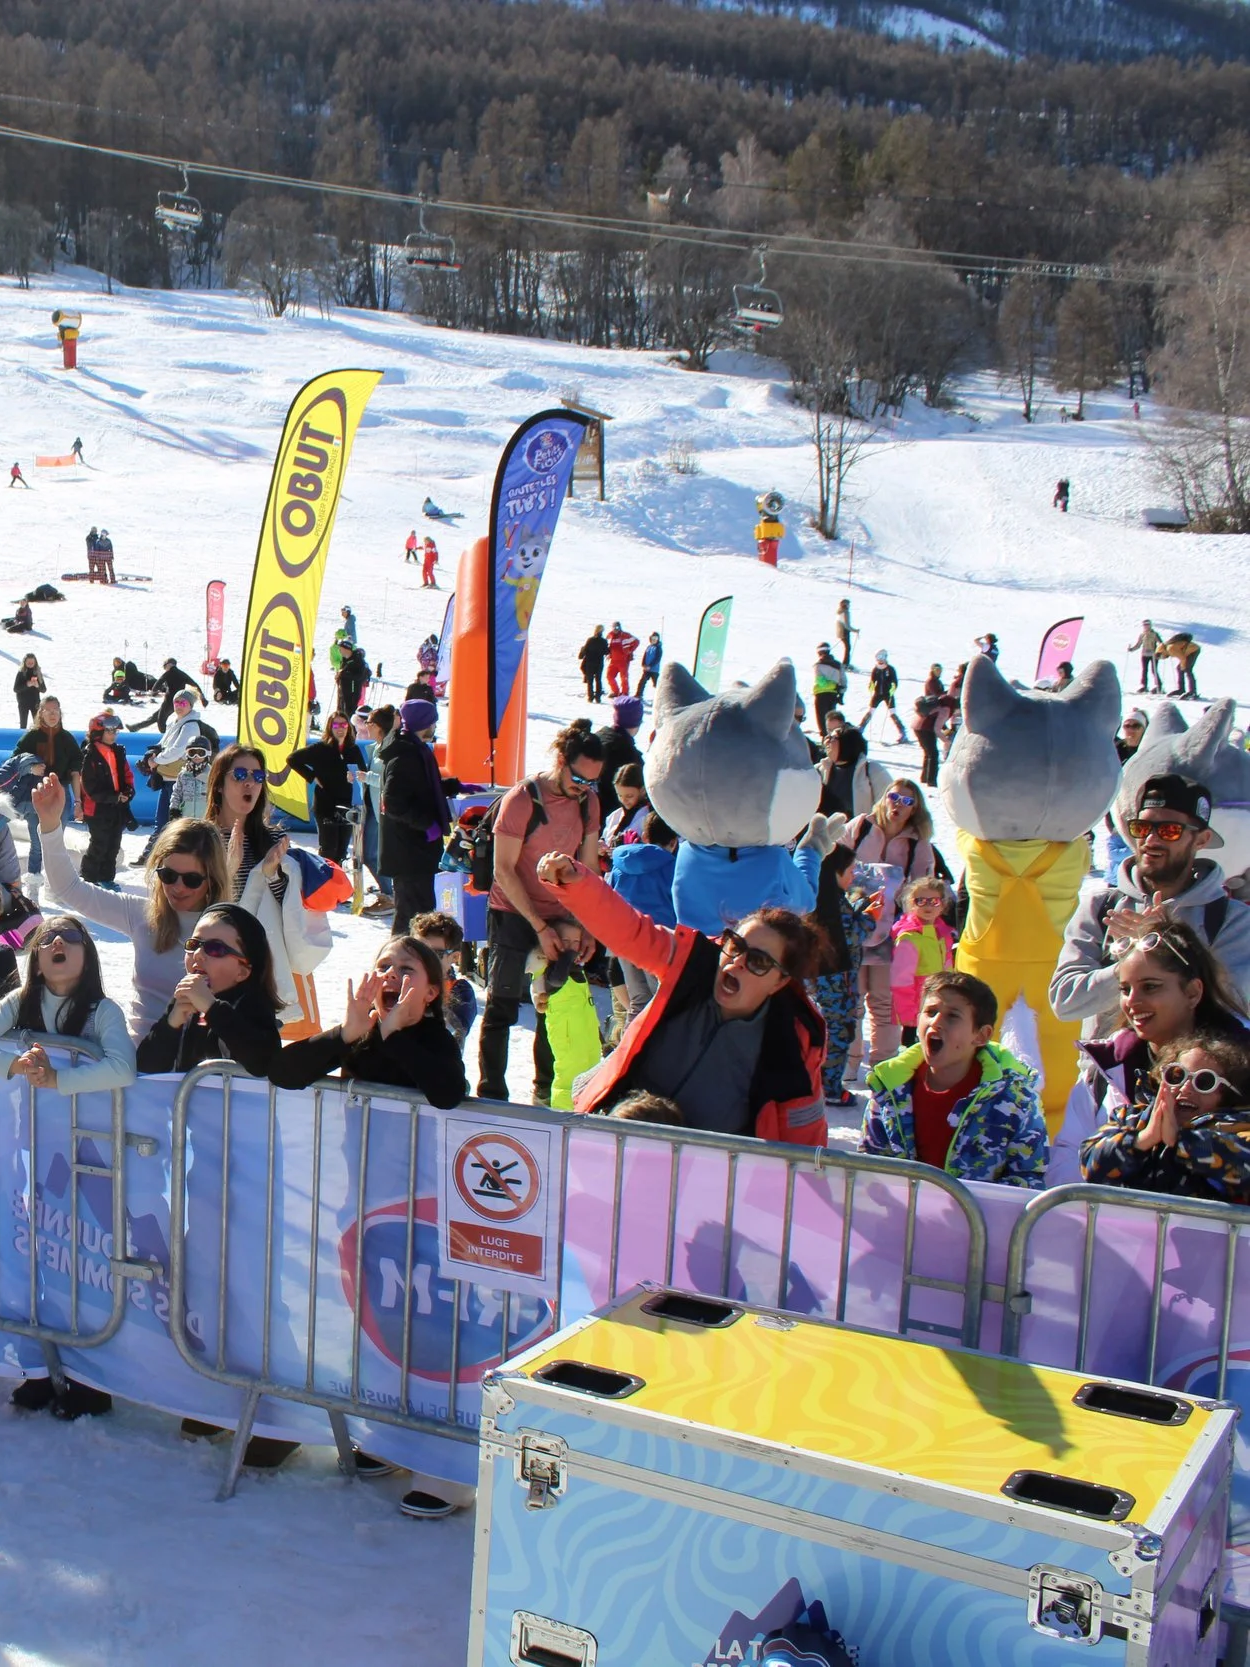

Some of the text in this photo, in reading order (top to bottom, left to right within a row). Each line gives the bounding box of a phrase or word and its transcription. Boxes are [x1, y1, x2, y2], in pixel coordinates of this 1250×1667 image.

[281, 420, 335, 537] OBUT
[540, 474, 558, 489] LES
[314, 503, 327, 537] PREMIER
[321, 489, 329, 503] EN
[253, 628, 295, 746] OBUT
[287, 711, 296, 746] PREMIER
[467, 1244, 523, 1265] INTERDITE
[480, 1234, 510, 1250] LUGE
[714, 1639, 744, 1660] LA
